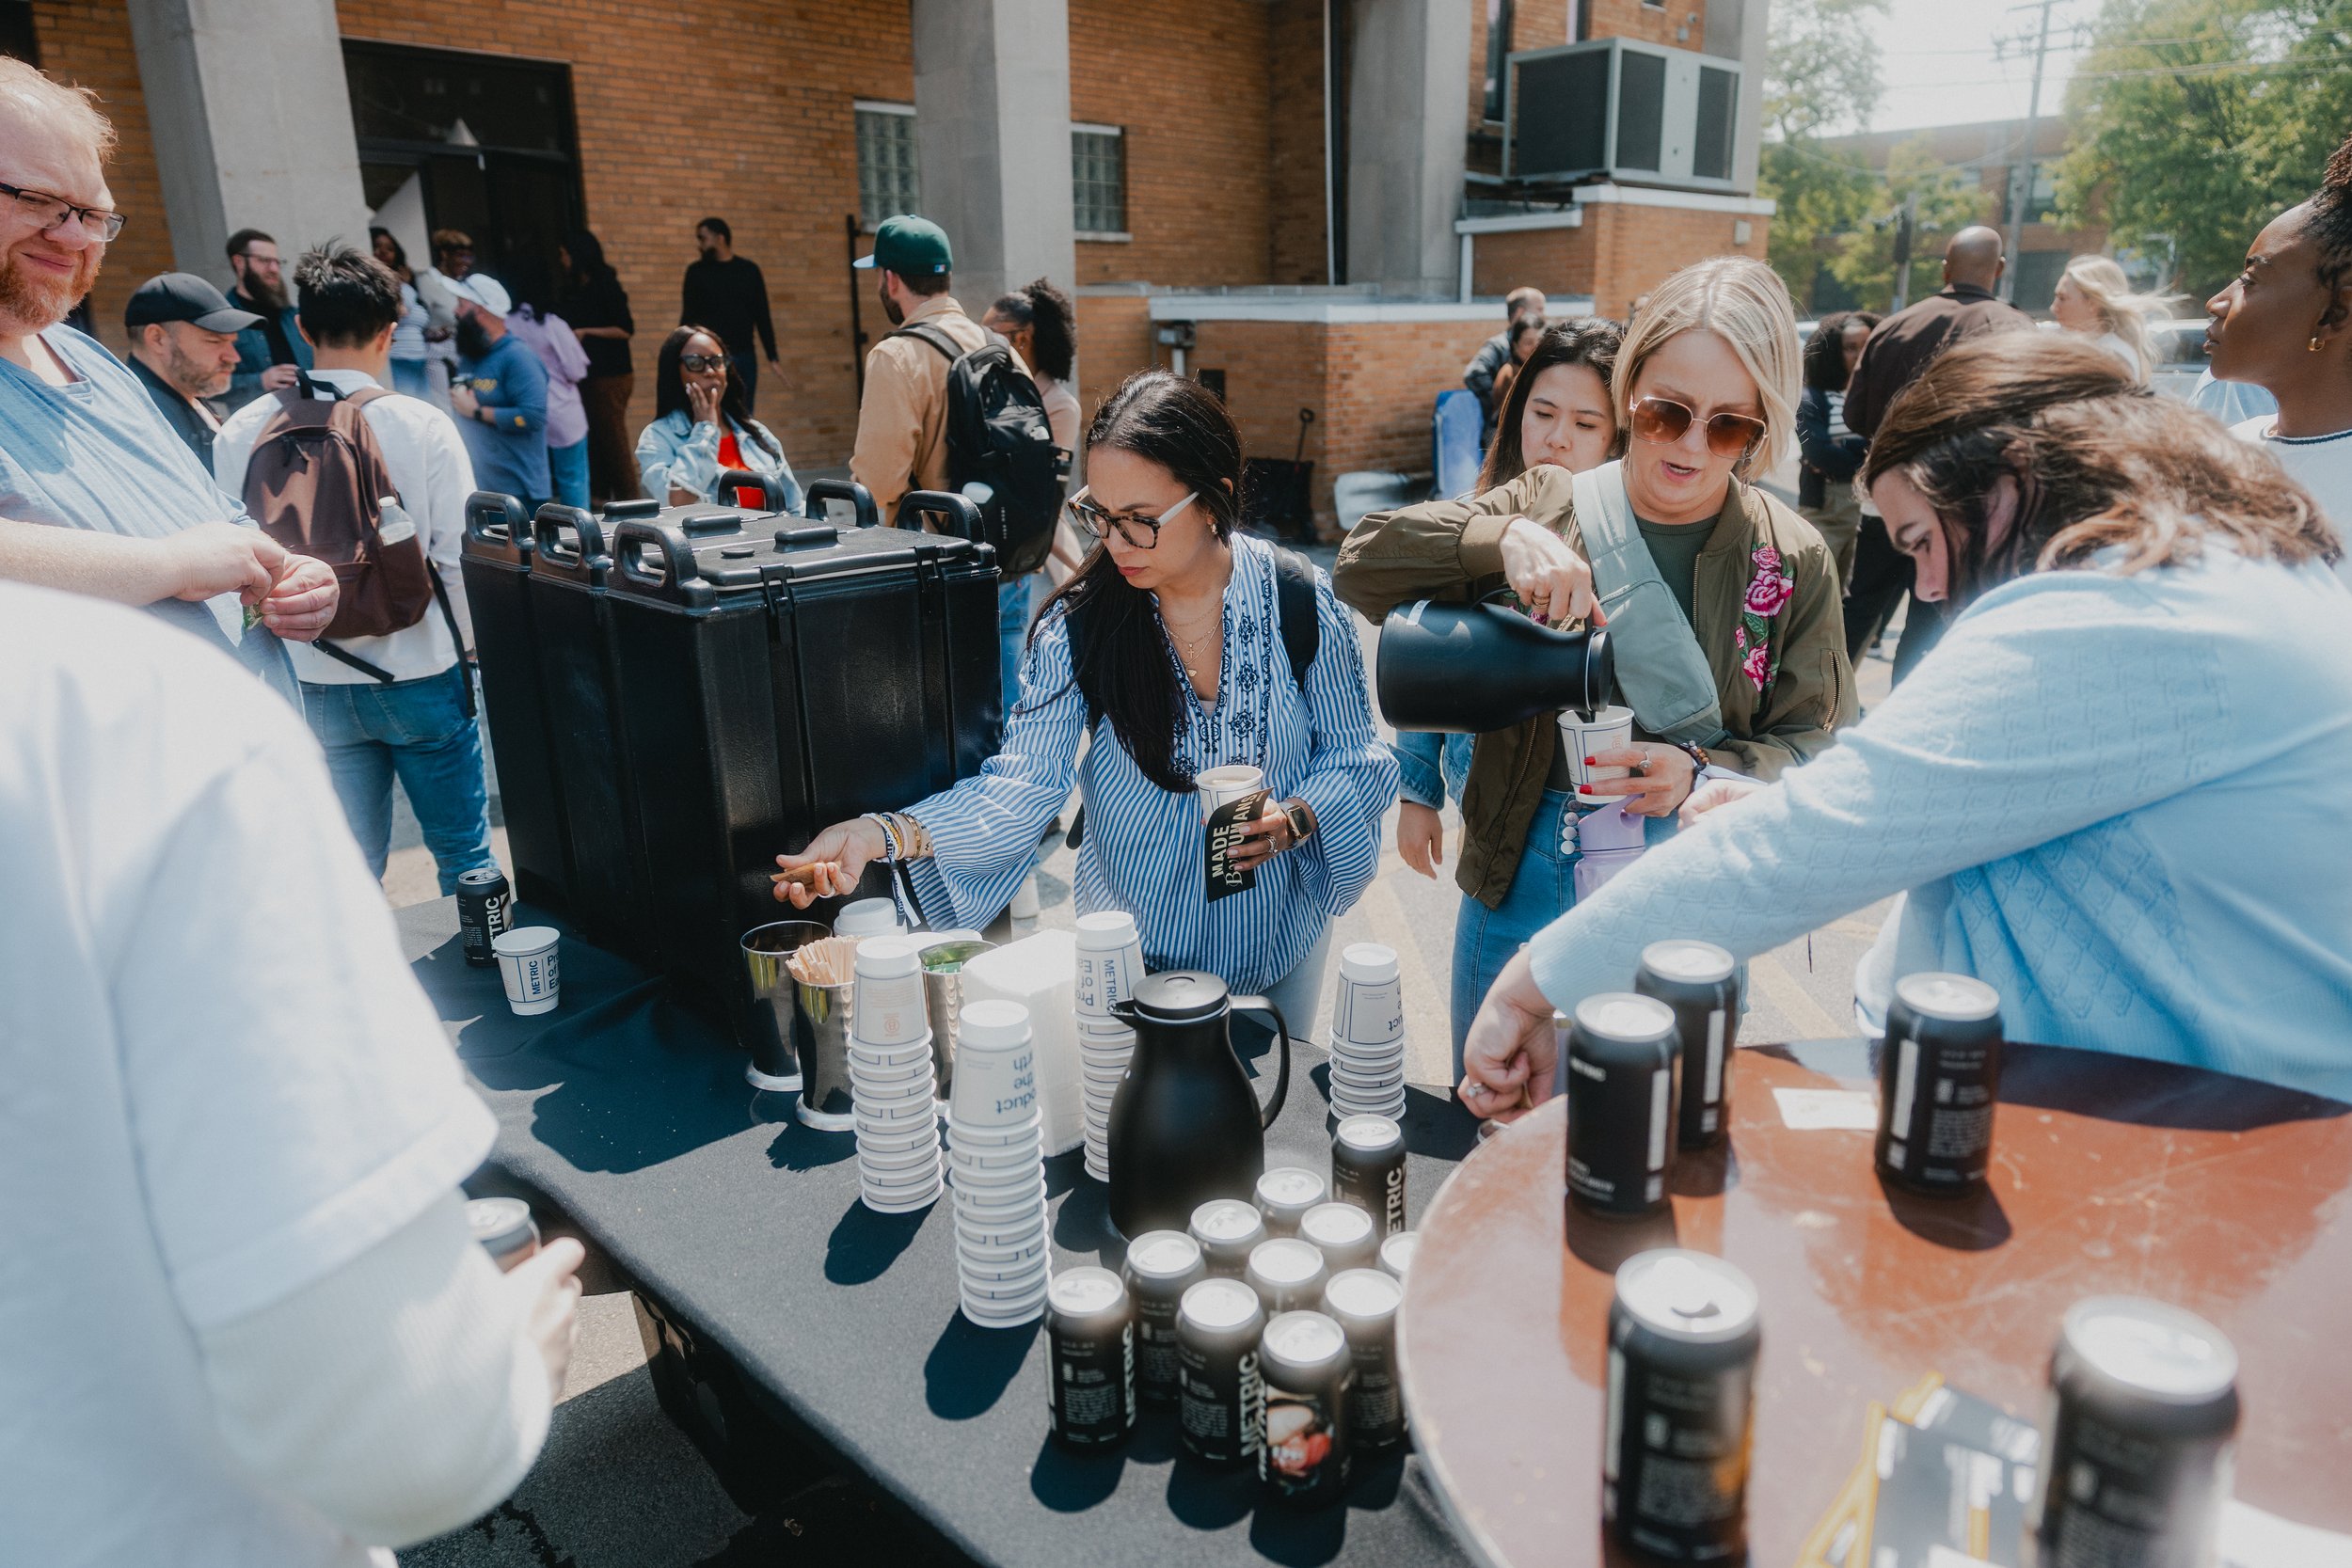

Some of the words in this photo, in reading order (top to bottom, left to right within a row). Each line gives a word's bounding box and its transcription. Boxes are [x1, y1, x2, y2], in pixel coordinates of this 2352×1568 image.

[1211, 825, 1231, 879] MADE
[1227, 793, 1258, 859] UMANS
[485, 896, 504, 958] TRIC
[529, 960, 541, 995] METRIC
[1387, 1167, 1403, 1238] ETRIC
[1239, 1350, 1261, 1457] METRIC
